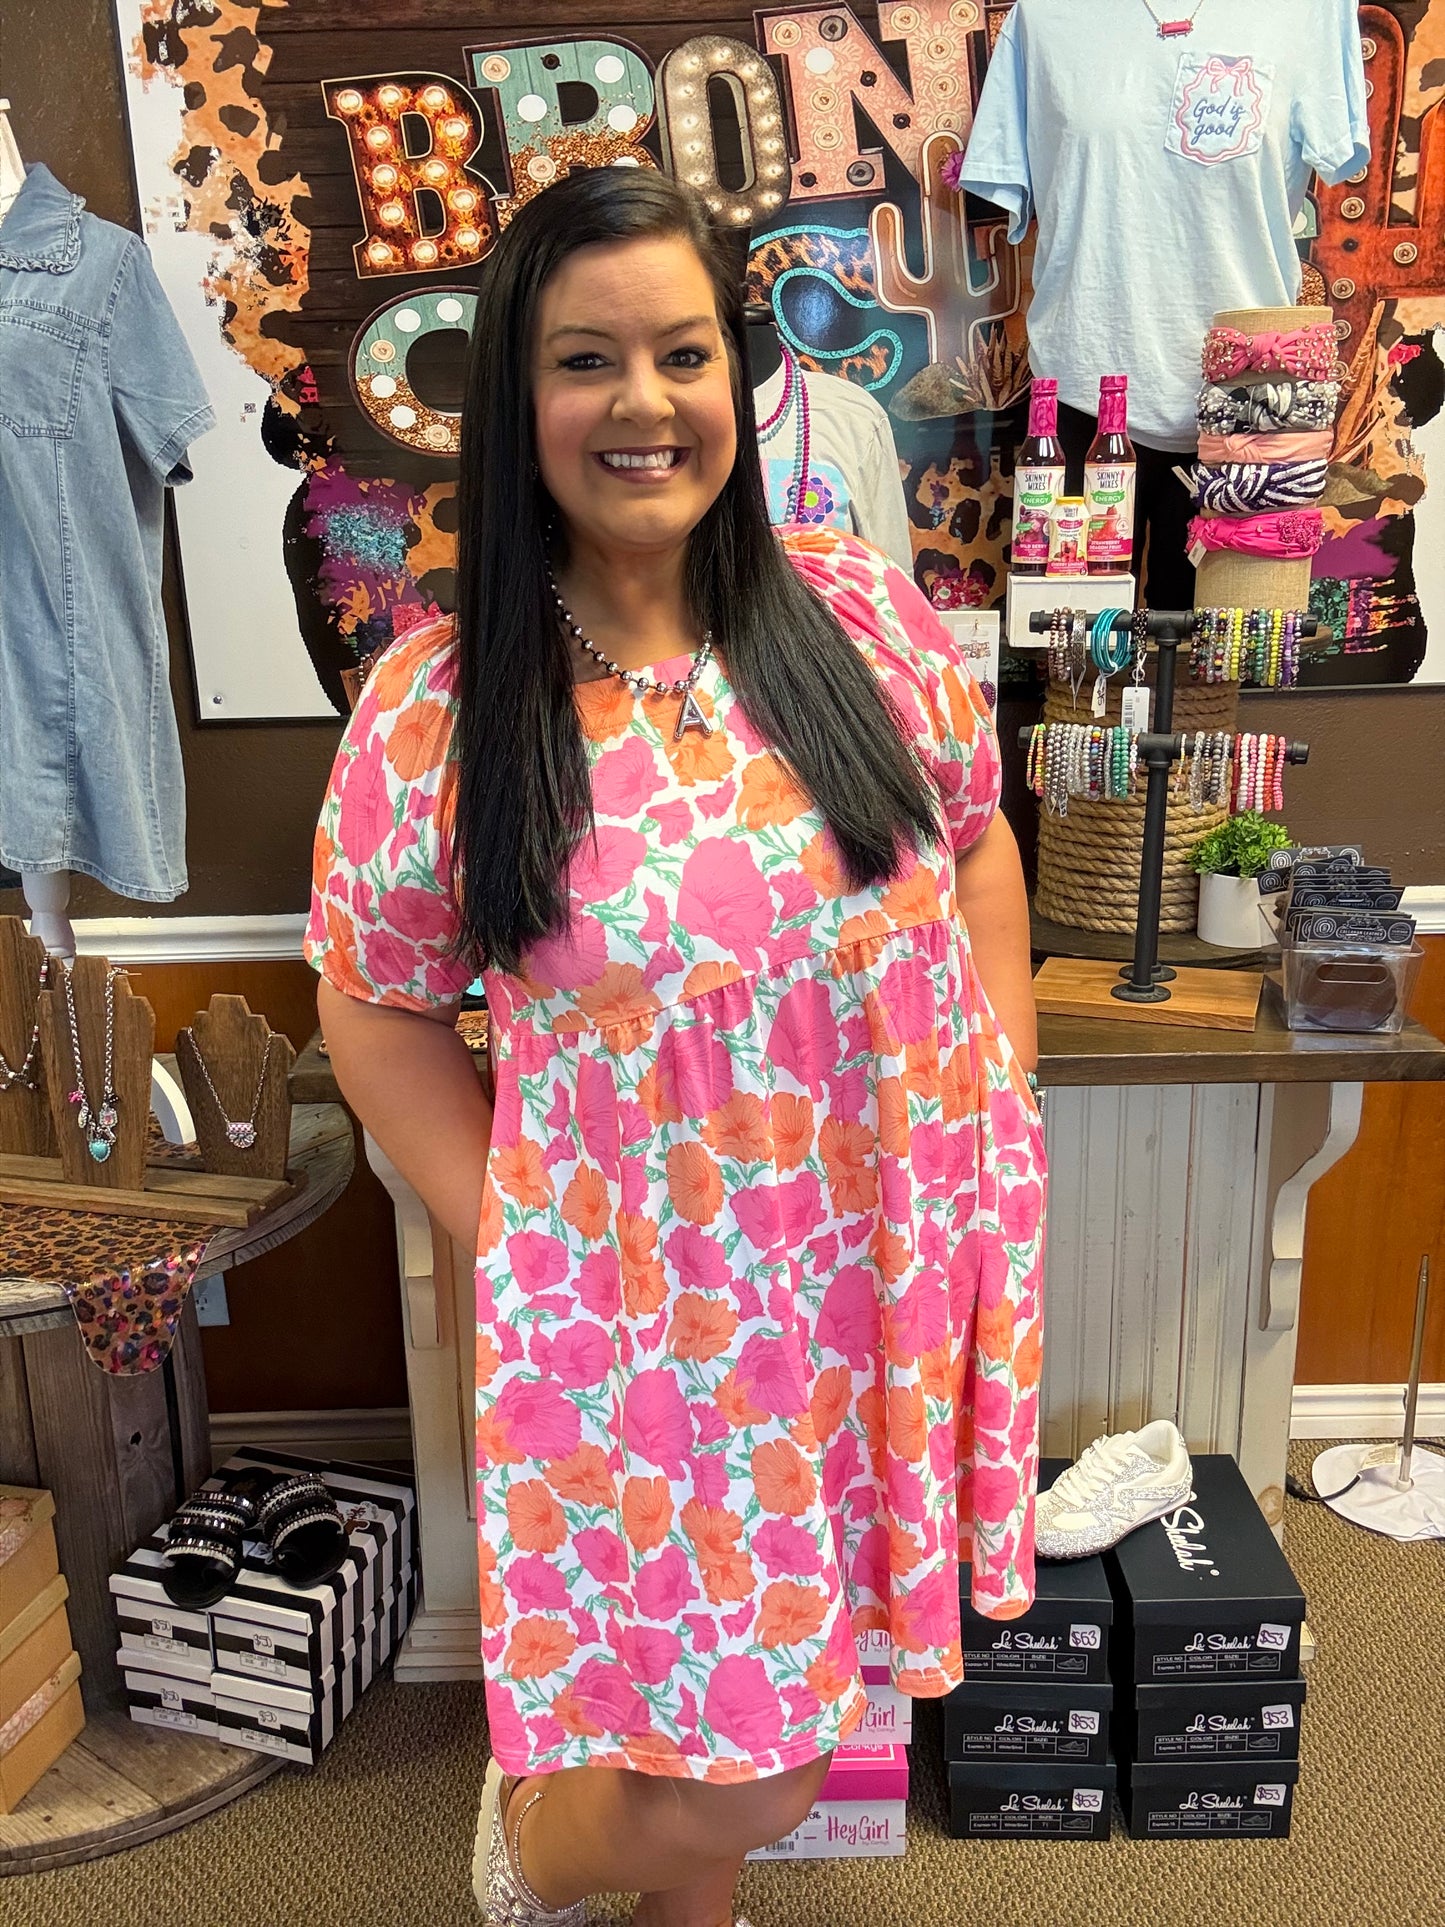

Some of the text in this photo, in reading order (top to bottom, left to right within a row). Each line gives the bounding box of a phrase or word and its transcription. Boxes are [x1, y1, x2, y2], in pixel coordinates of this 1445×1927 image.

[1193, 96, 1246, 123] God is
[1191, 117, 1241, 145] good
[1025, 474, 1047, 482] SKINNY
[1097, 471, 1120, 480] SKINNY
[1028, 482, 1046, 490] MIXES
[1100, 480, 1118, 488] MIXES
[1263, 1711, 1289, 1726] $53
[1074, 1792, 1100, 1808] $53
[1256, 1787, 1280, 1801] $53
[825, 1815, 889, 1846] HeyGirl
